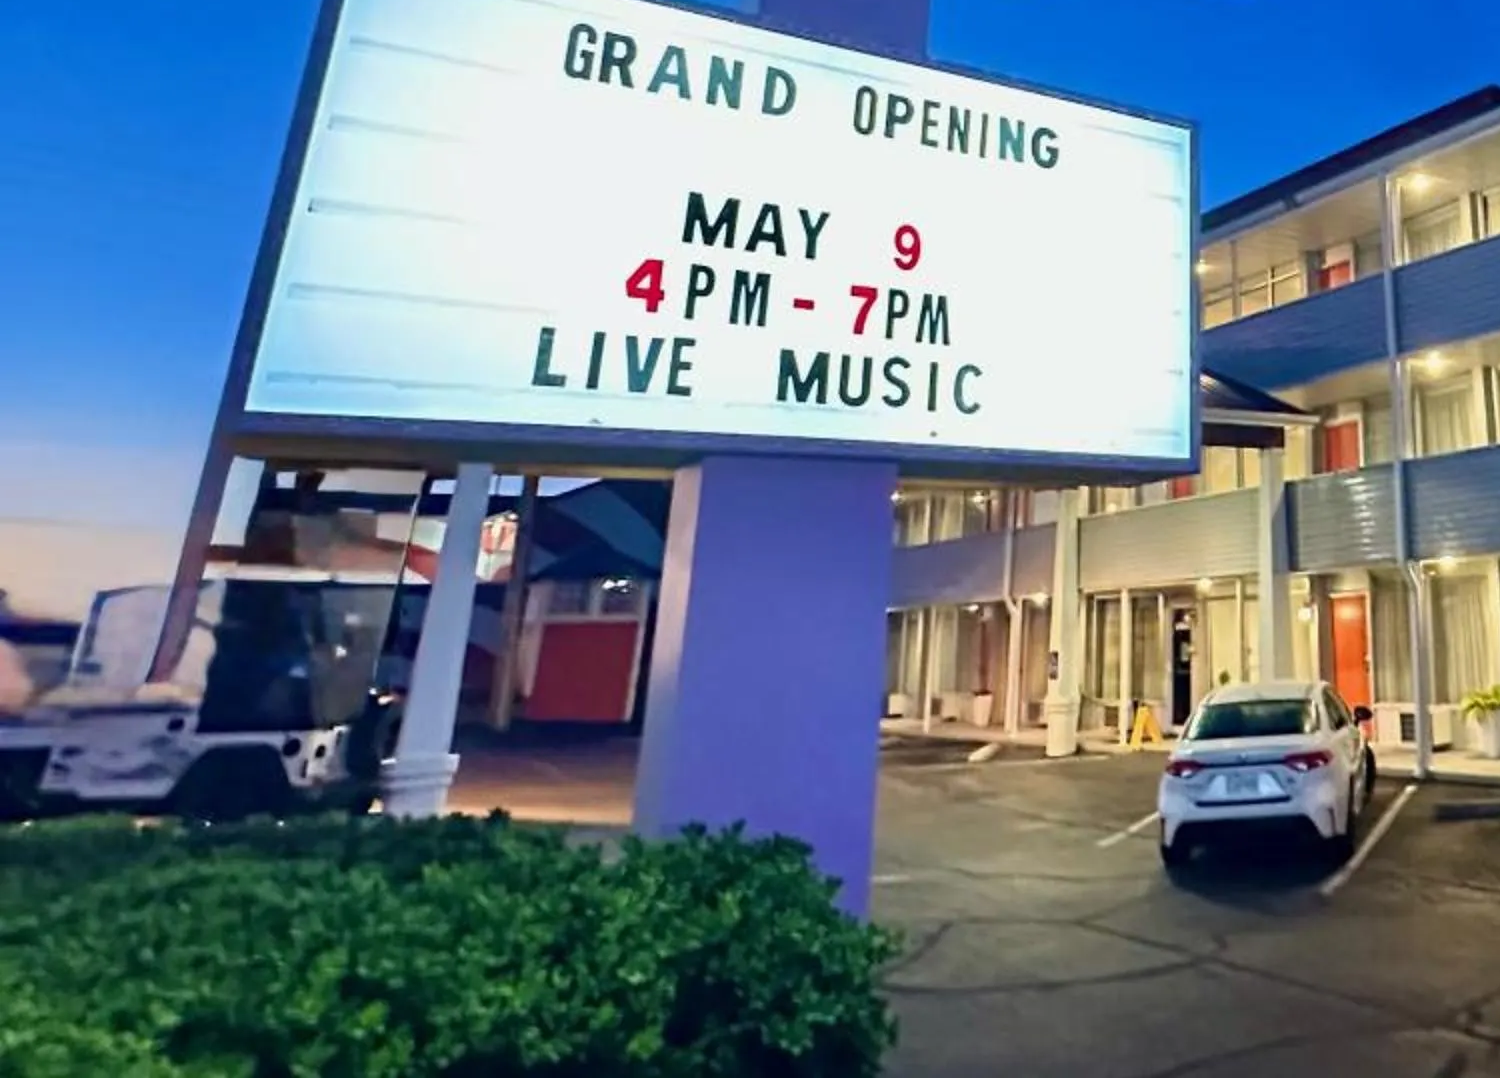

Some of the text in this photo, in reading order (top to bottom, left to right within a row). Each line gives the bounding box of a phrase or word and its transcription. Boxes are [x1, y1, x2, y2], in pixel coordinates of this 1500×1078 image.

[563, 23, 1059, 169] GRAND OPENING
[681, 191, 922, 271] MAY 9
[849, 284, 951, 347] 7PM
[531, 326, 983, 415] LIVE MUSIC
